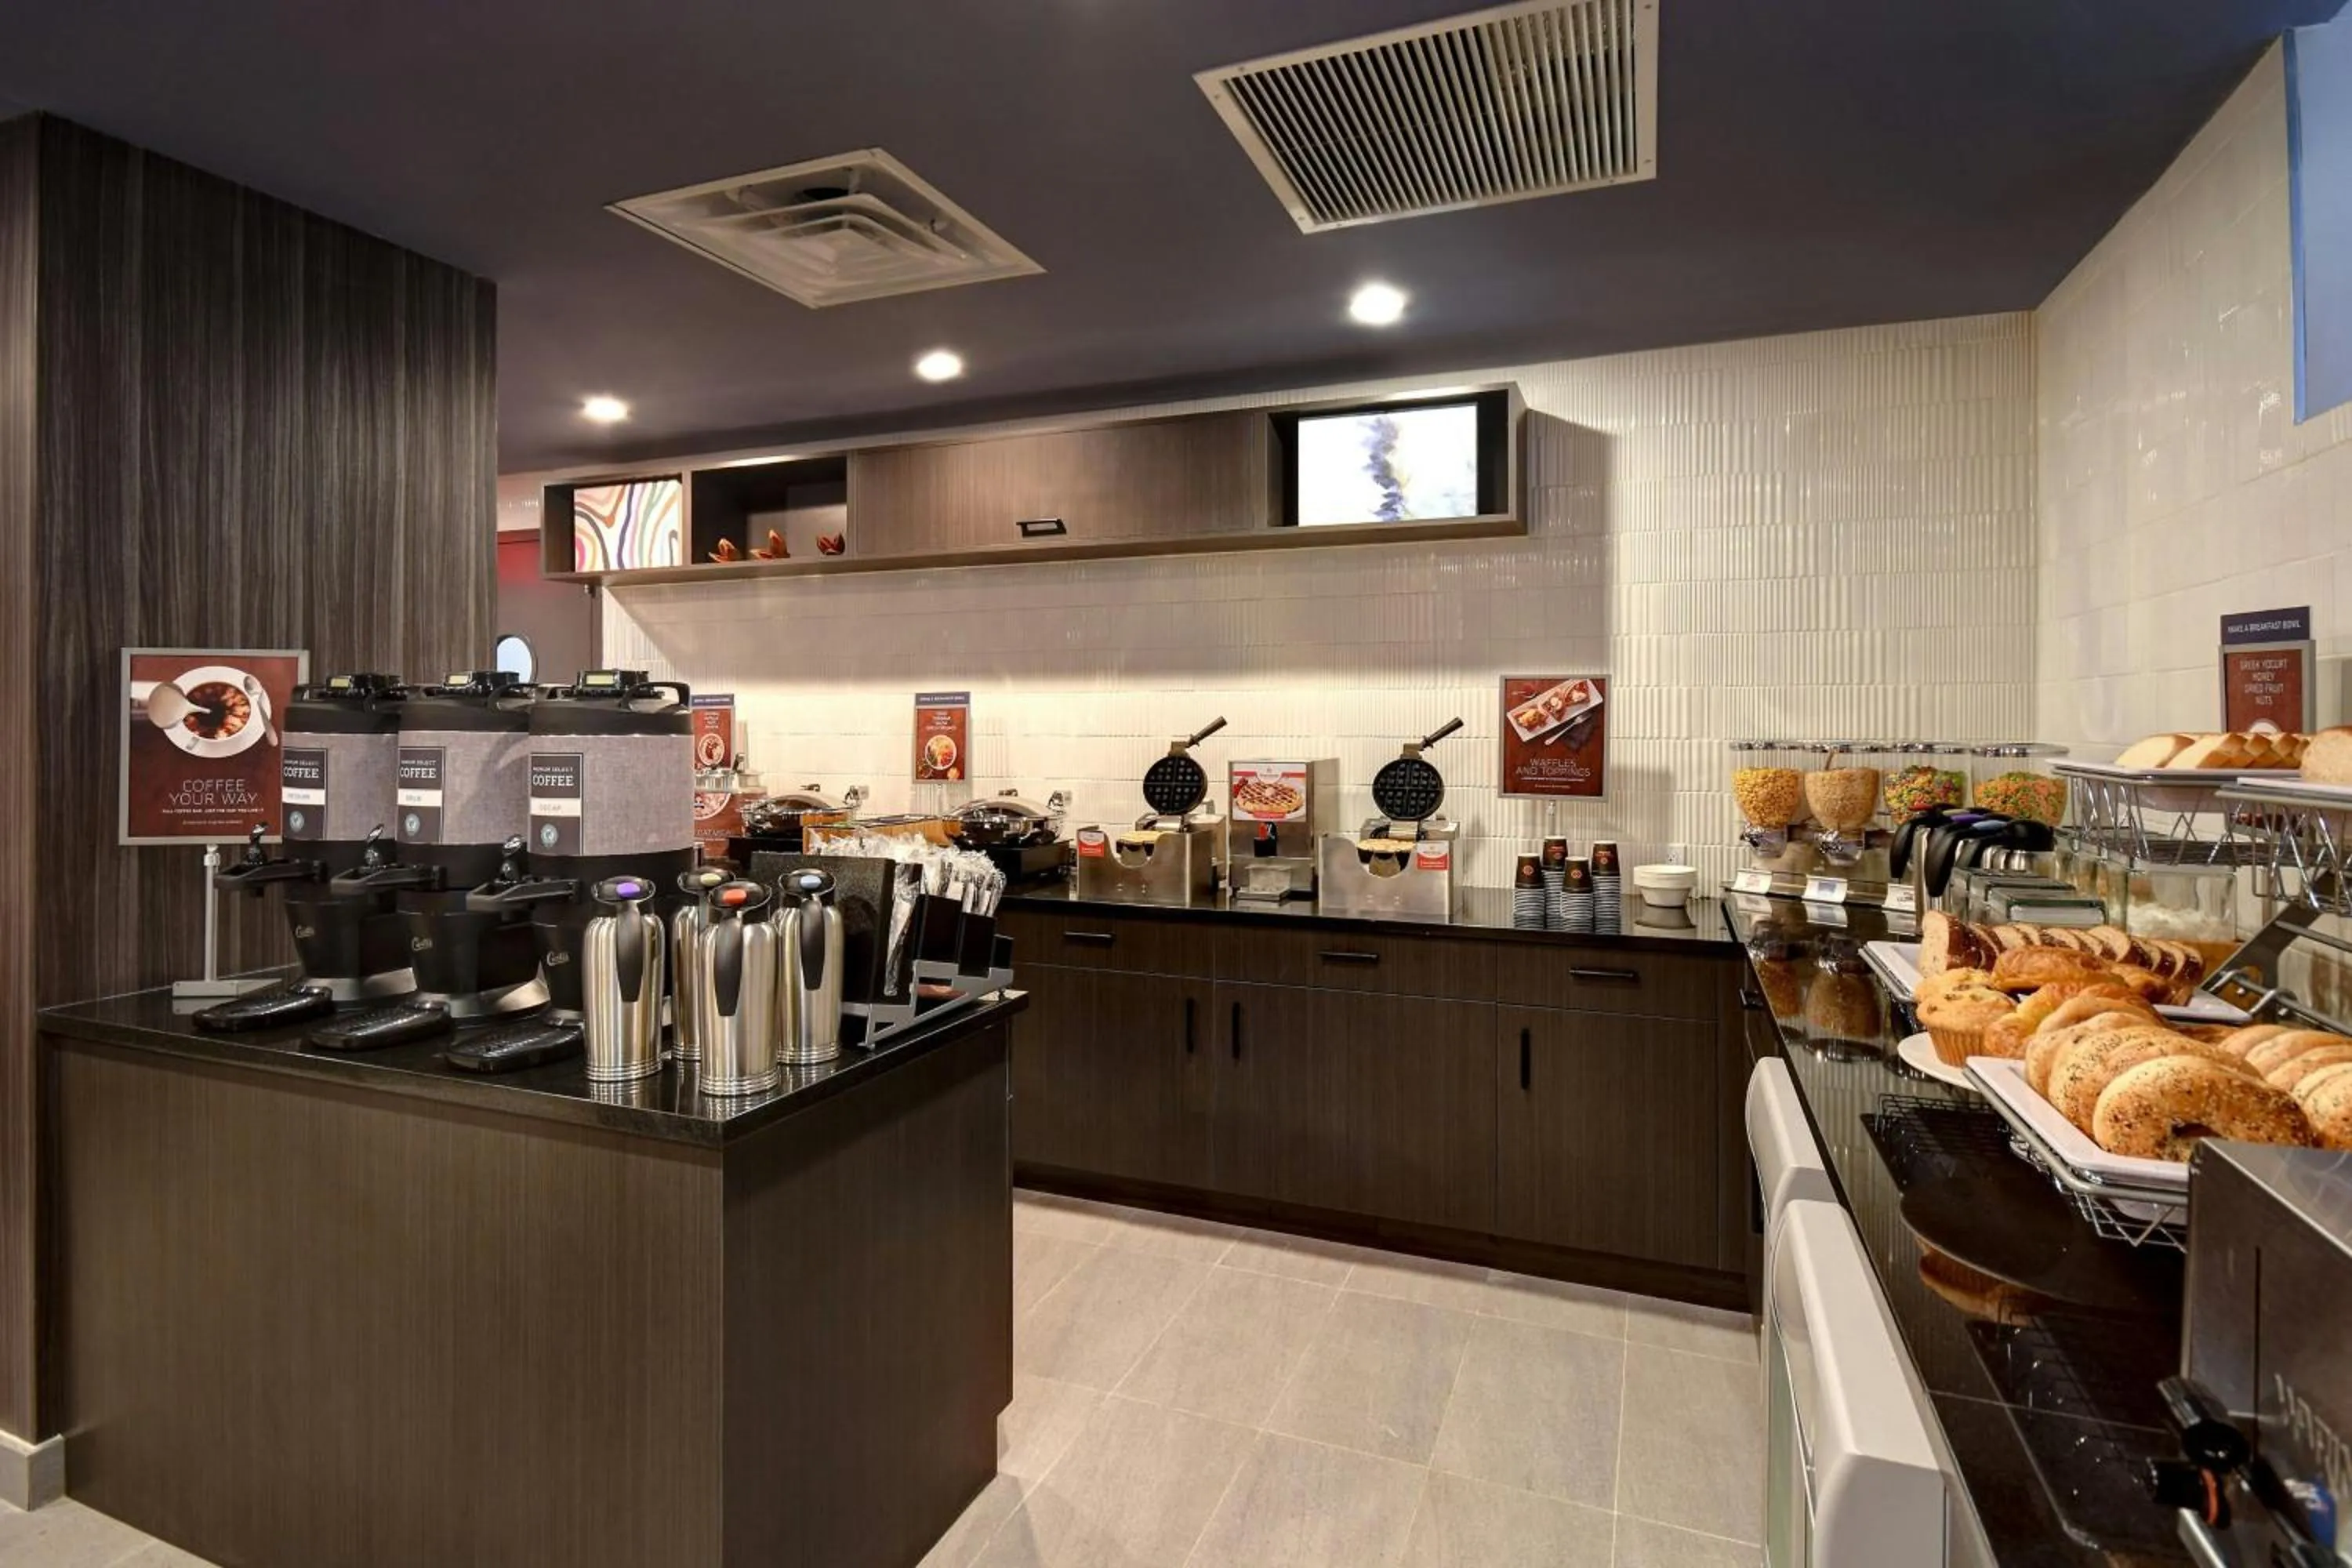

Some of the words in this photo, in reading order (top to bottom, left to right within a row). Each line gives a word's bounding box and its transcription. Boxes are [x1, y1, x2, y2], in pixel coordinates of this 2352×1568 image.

[1530, 758, 1577, 768] WAFFLES
[283, 766, 319, 779] COFFEE
[399, 767, 437, 779] COFFEE
[1515, 766, 1538, 775] AND
[1541, 767, 1591, 776] TOPPINGS
[183, 779, 245, 793] COFFEE
[532, 775, 574, 786] COFFEE
[169, 793, 215, 806] YOUR
[221, 793, 259, 805] WAY
